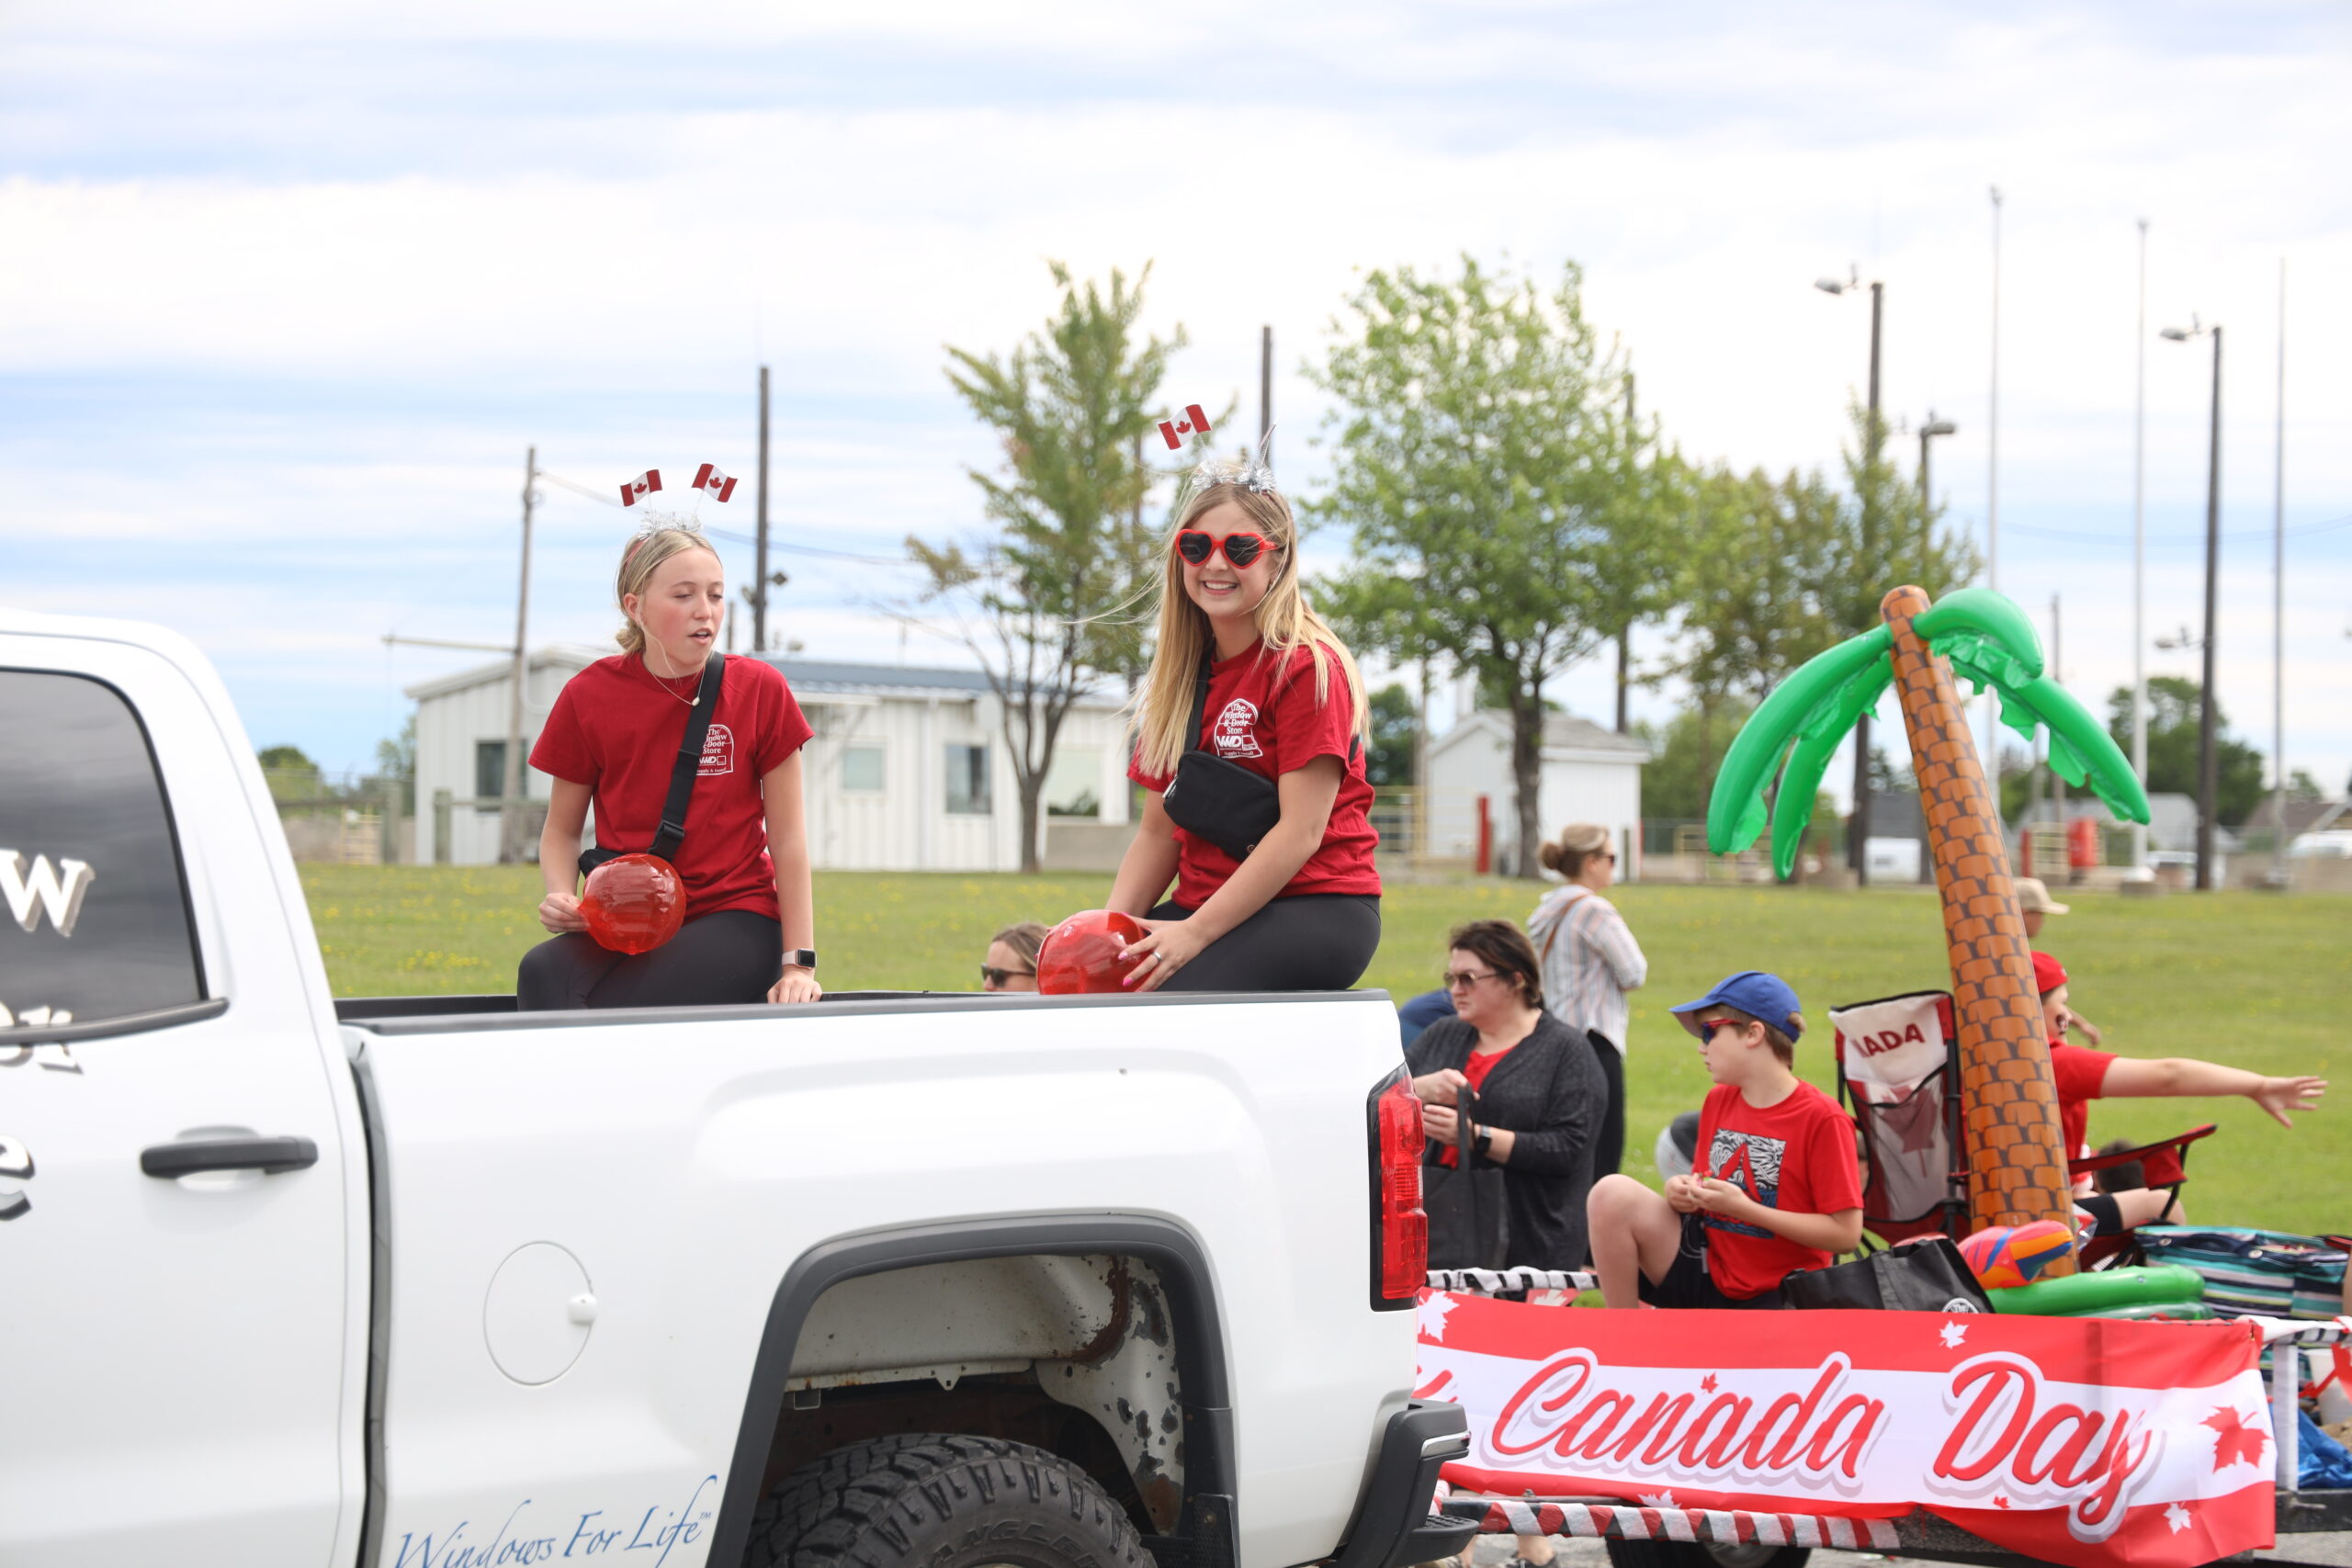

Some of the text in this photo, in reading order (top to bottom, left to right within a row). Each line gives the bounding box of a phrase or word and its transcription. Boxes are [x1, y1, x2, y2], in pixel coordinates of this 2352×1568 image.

[1233, 703, 1246, 712] The
[707, 728, 719, 736] The
[1491, 1355, 2154, 1528] Canada Day
[395, 1499, 556, 1568] Windows
[563, 1510, 622, 1558] For
